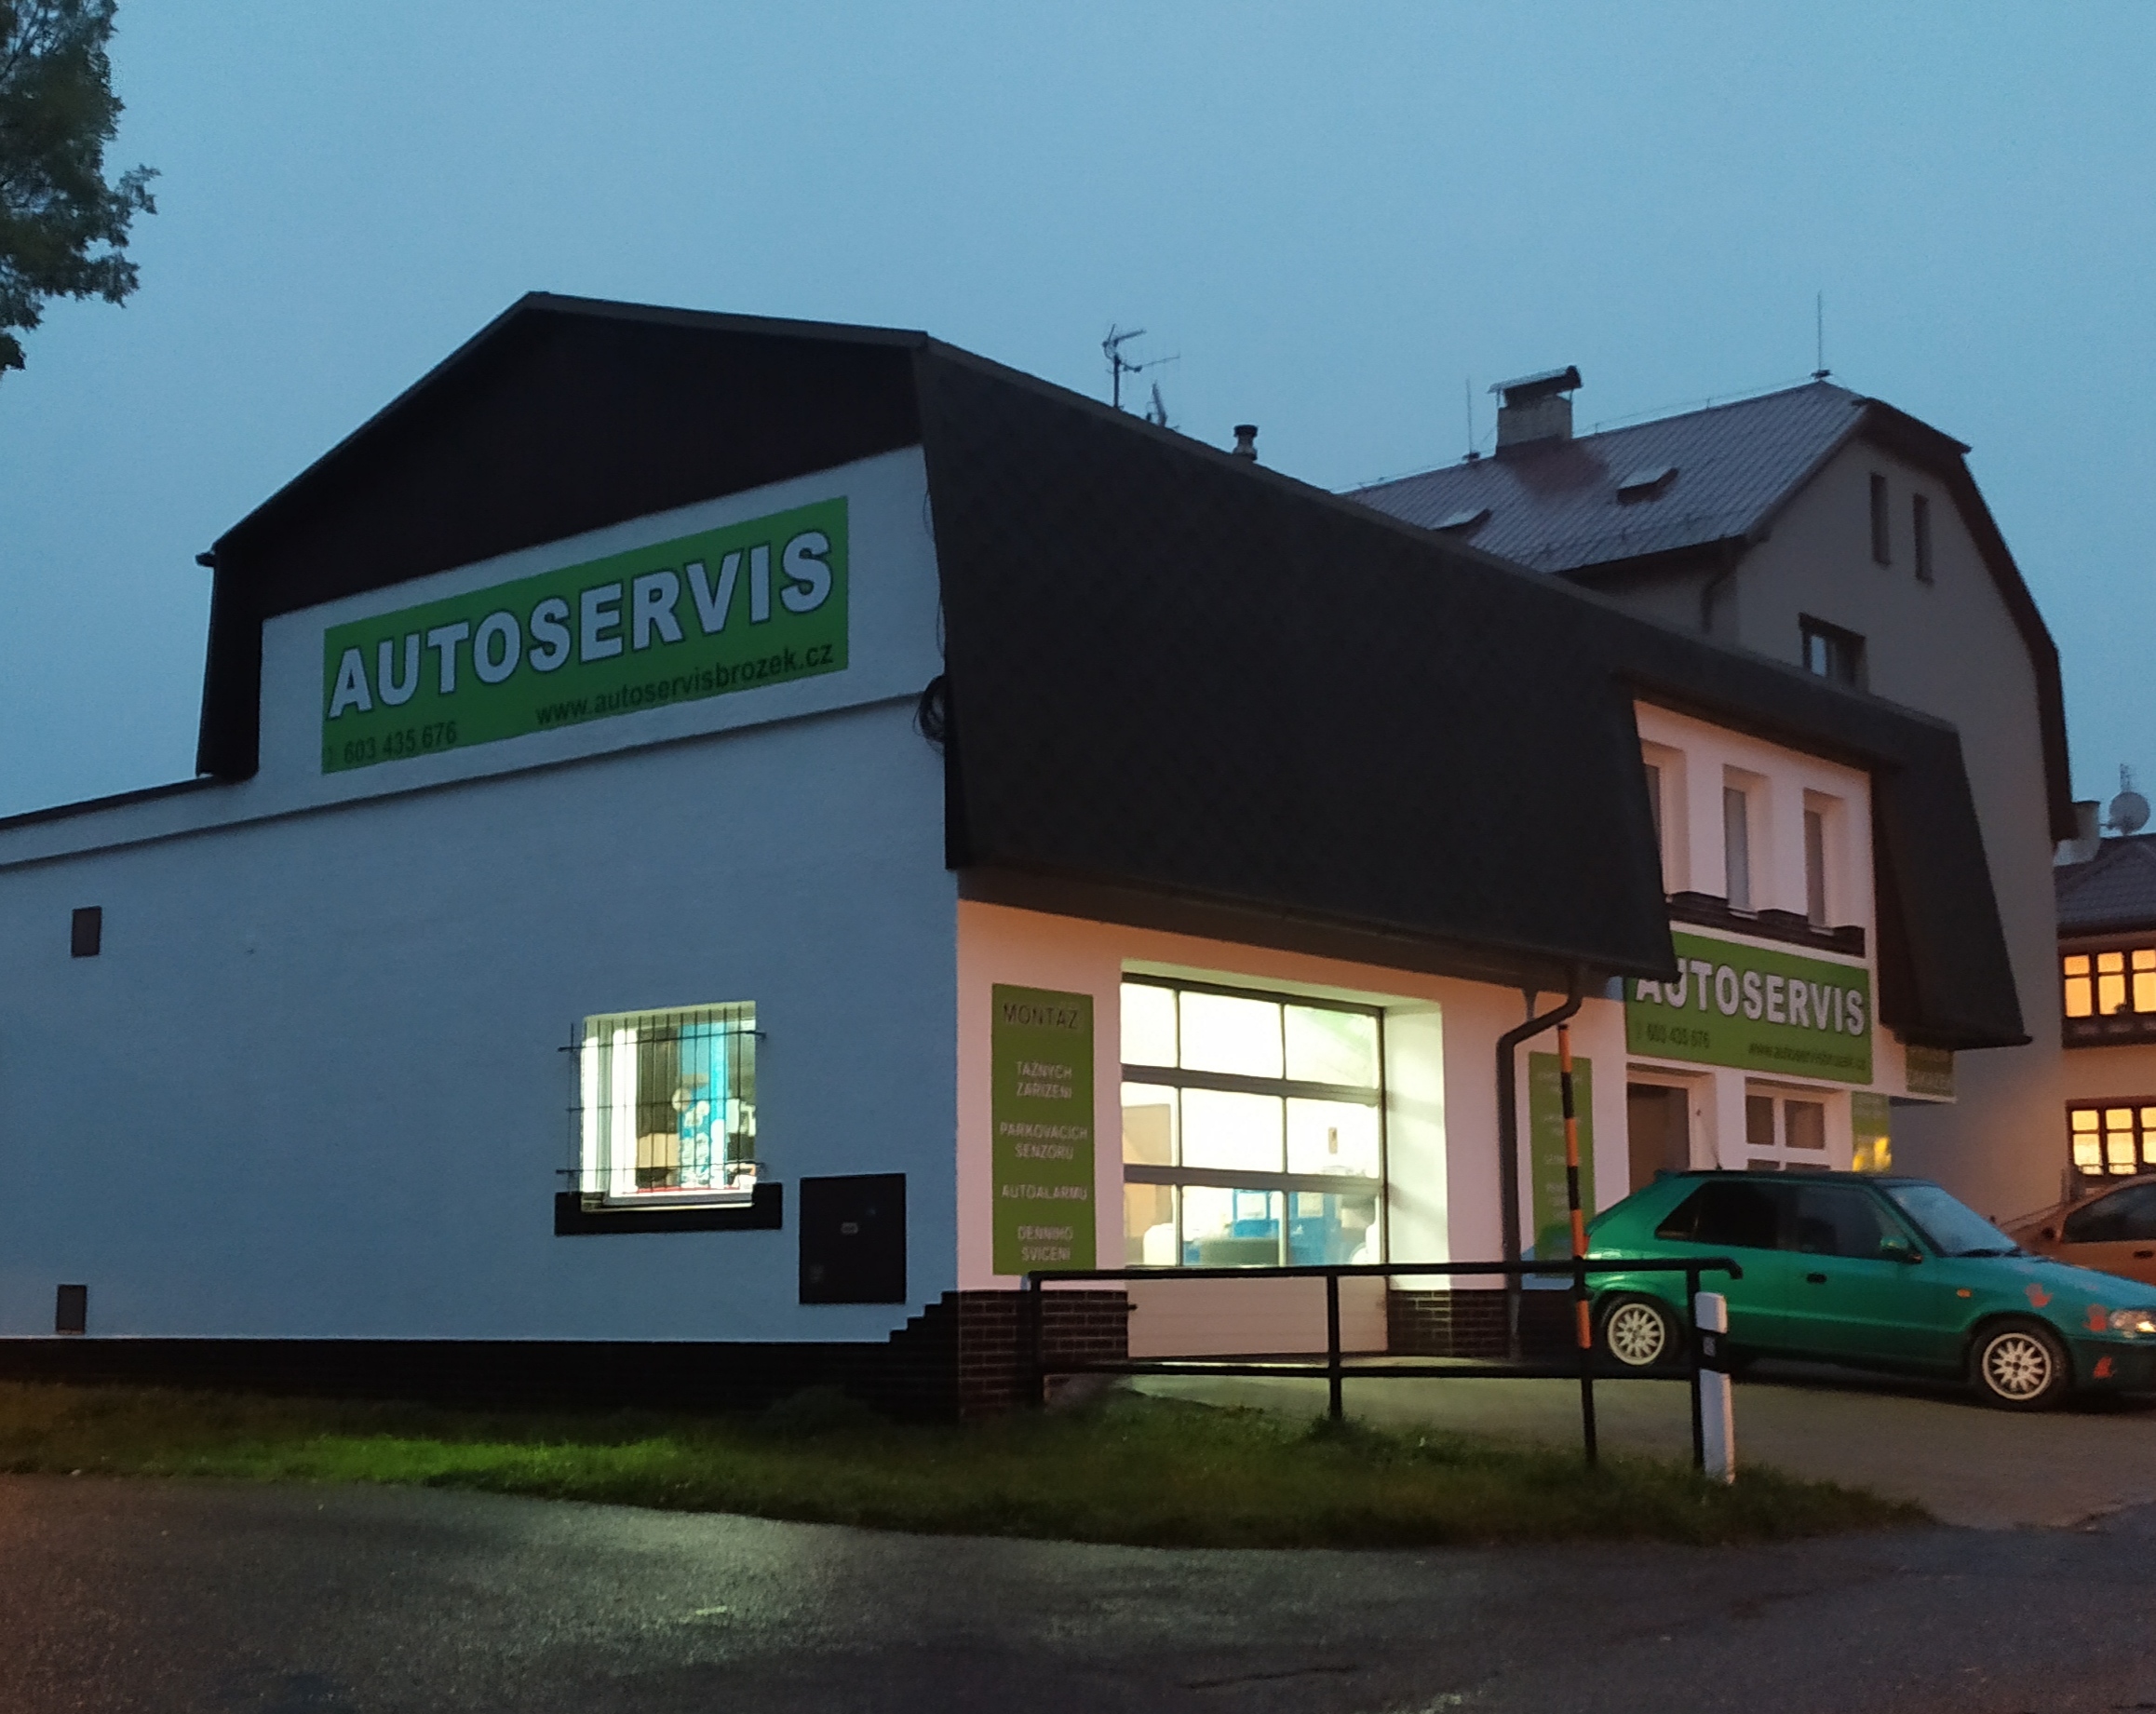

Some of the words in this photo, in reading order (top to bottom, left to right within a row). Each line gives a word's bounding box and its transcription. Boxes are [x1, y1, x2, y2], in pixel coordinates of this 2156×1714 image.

[326, 529, 833, 721] AUTOSERVIS
[535, 642, 834, 725] www.autoservisbrozek.cz
[344, 736, 376, 764] 603
[383, 728, 417, 757] 435
[422, 721, 458, 749] 676
